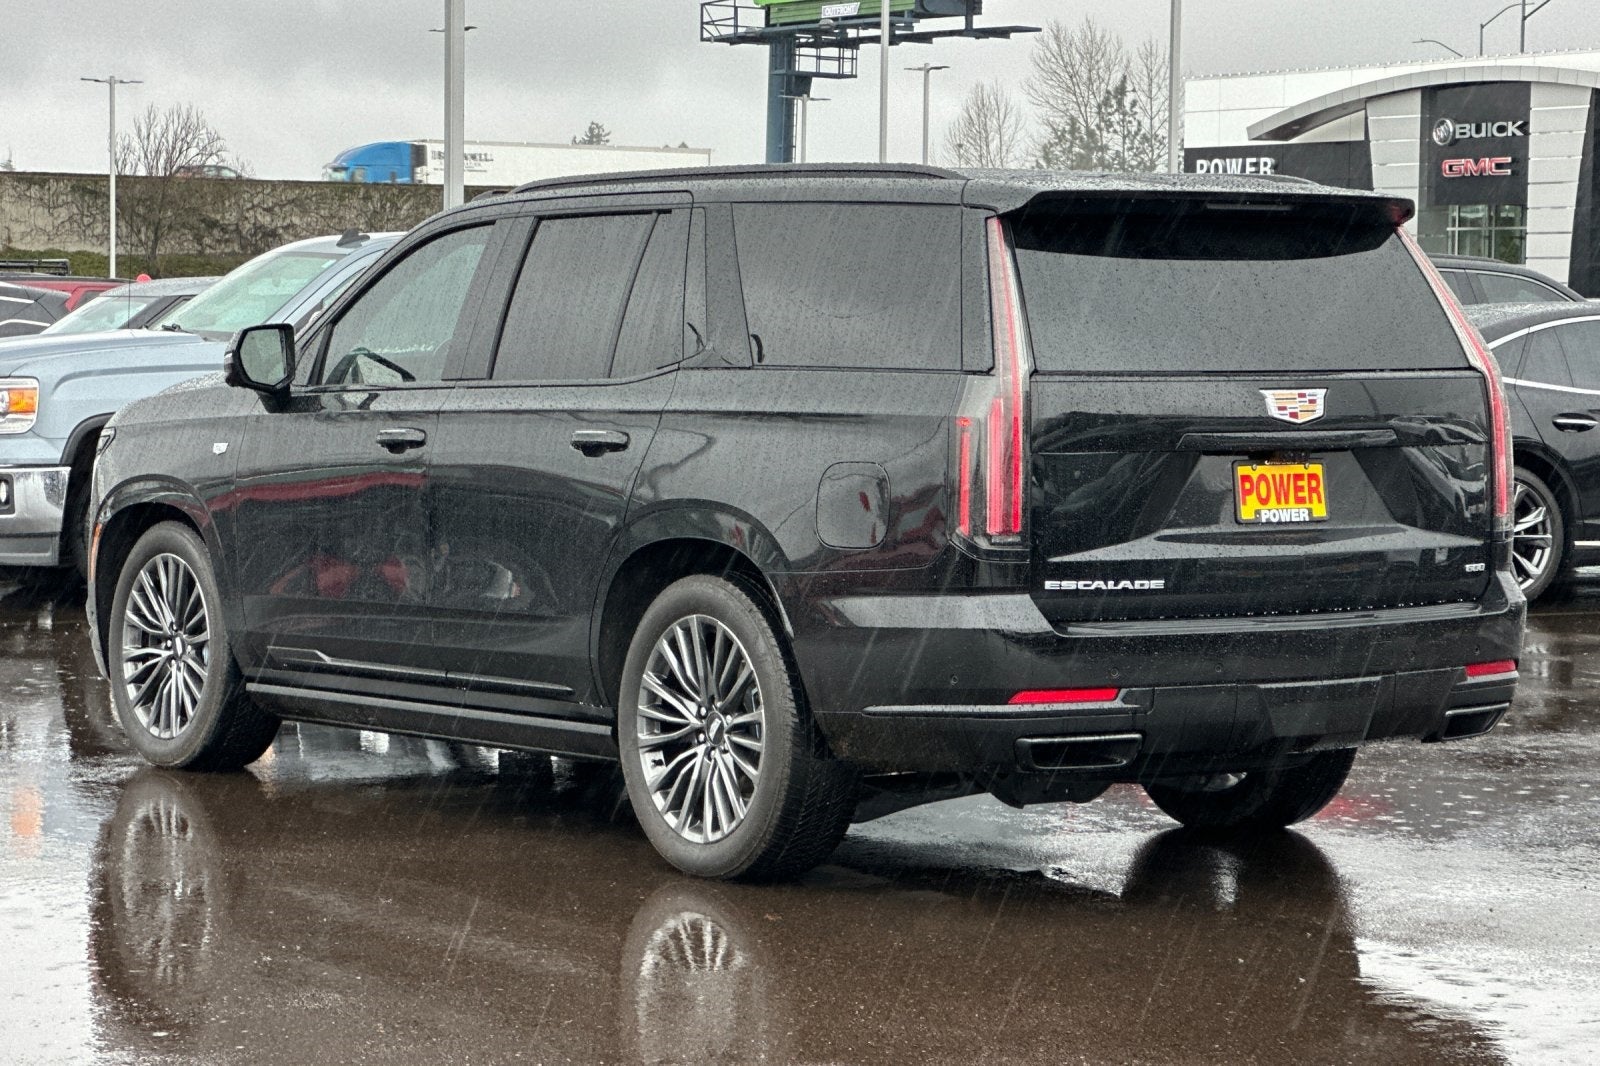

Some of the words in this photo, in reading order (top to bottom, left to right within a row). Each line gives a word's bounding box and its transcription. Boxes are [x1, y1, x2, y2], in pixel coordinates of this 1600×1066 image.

[1455, 121, 1524, 138] BUICK
[1196, 157, 1274, 174] POWER
[1442, 157, 1511, 177] GMC
[1240, 473, 1322, 507] POWER
[1261, 508, 1310, 522] POWER
[1044, 579, 1165, 590] ESCALADE
